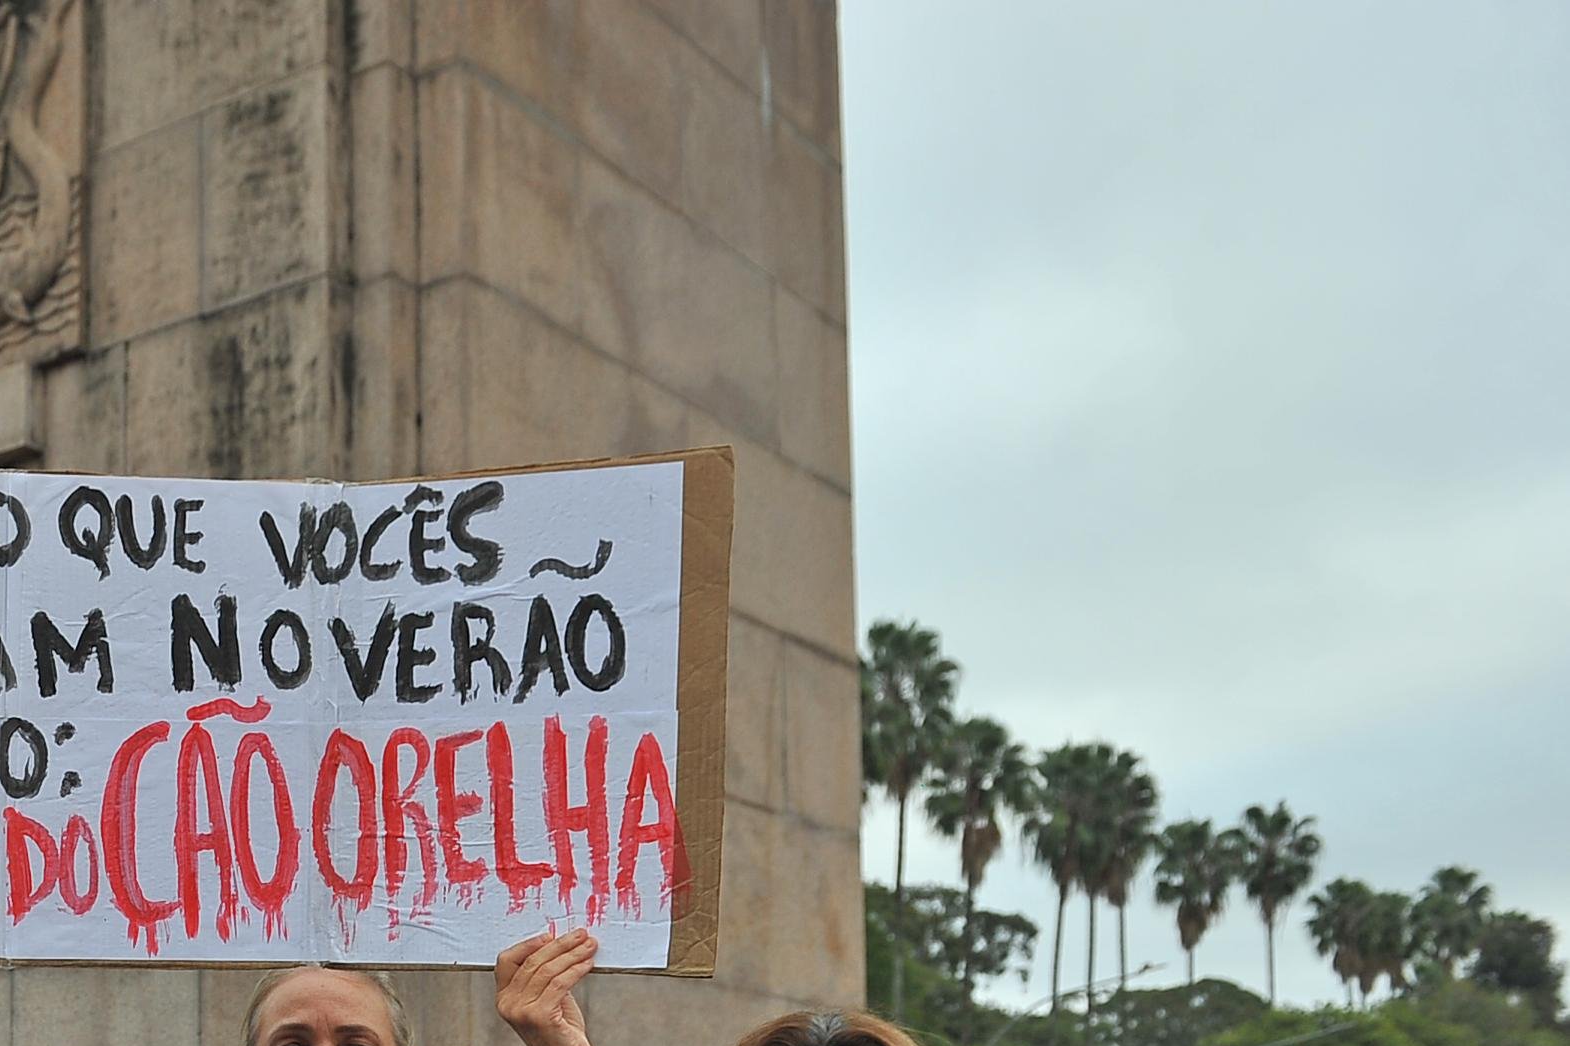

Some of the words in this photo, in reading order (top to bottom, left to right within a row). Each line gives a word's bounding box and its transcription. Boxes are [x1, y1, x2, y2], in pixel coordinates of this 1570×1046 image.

[59, 485, 206, 580] QUE
[260, 481, 505, 589] VOCÊS
[172, 590, 312, 693] NO
[3, 806, 98, 925] DO
[101, 695, 301, 955] CÃO
[312, 713, 691, 945] ORELHA
